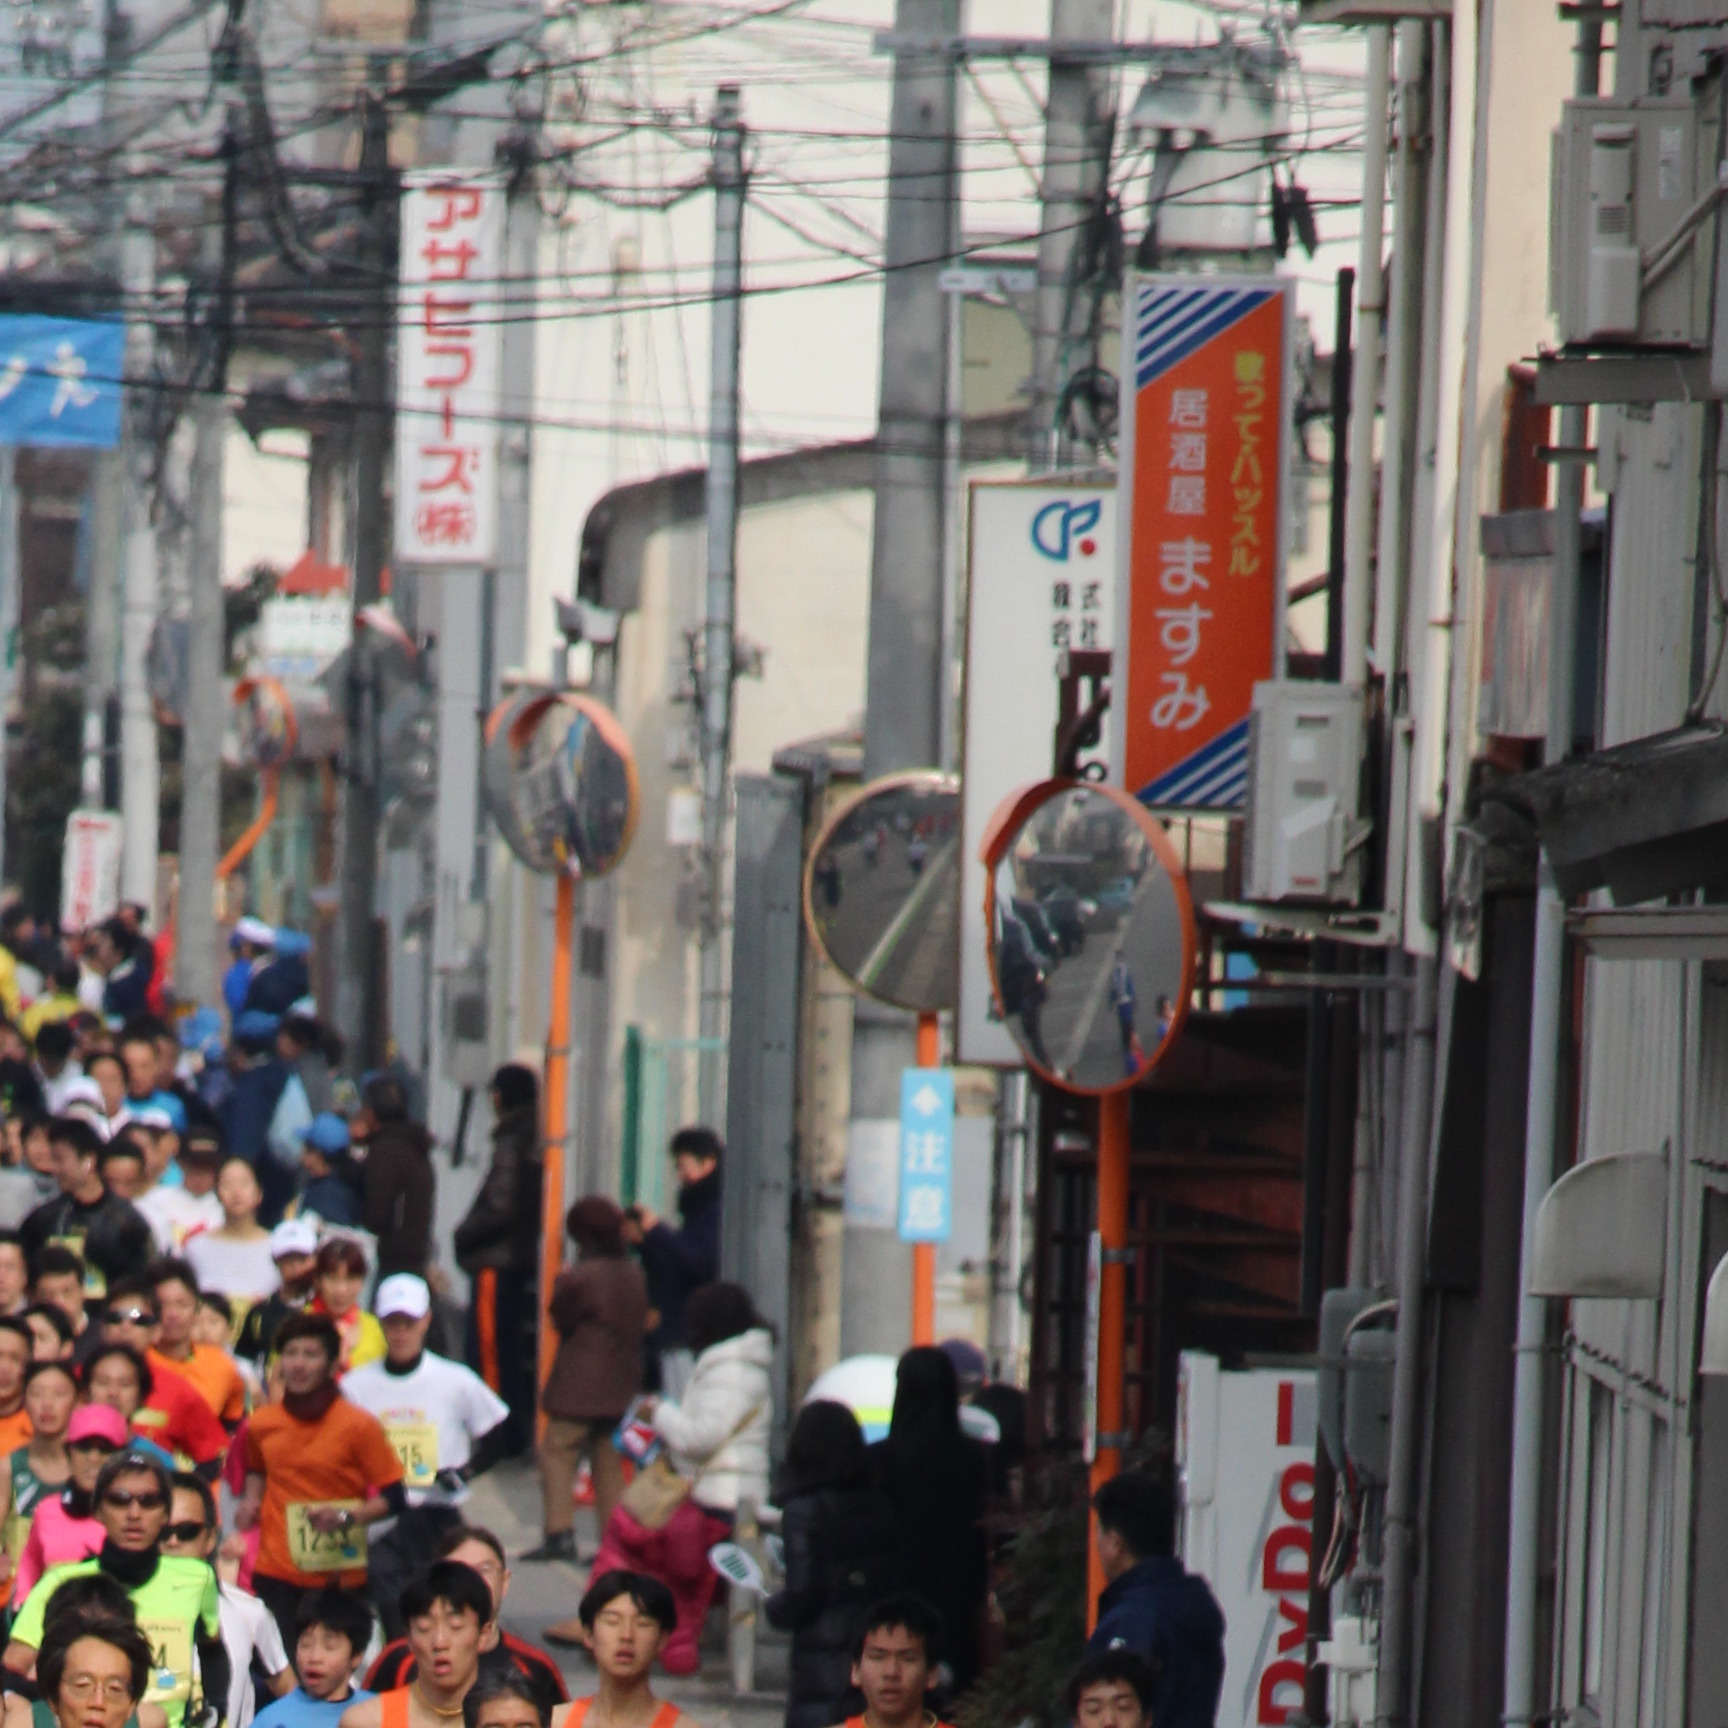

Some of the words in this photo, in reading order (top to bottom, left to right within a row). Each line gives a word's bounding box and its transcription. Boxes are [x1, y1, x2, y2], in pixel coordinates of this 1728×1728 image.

[1165, 388, 1209, 516] 居酒屋
[1150, 535, 1213, 731] ますみ
[905, 1130, 946, 1232] 注意
[1257, 1461, 1316, 1727] DyDo
